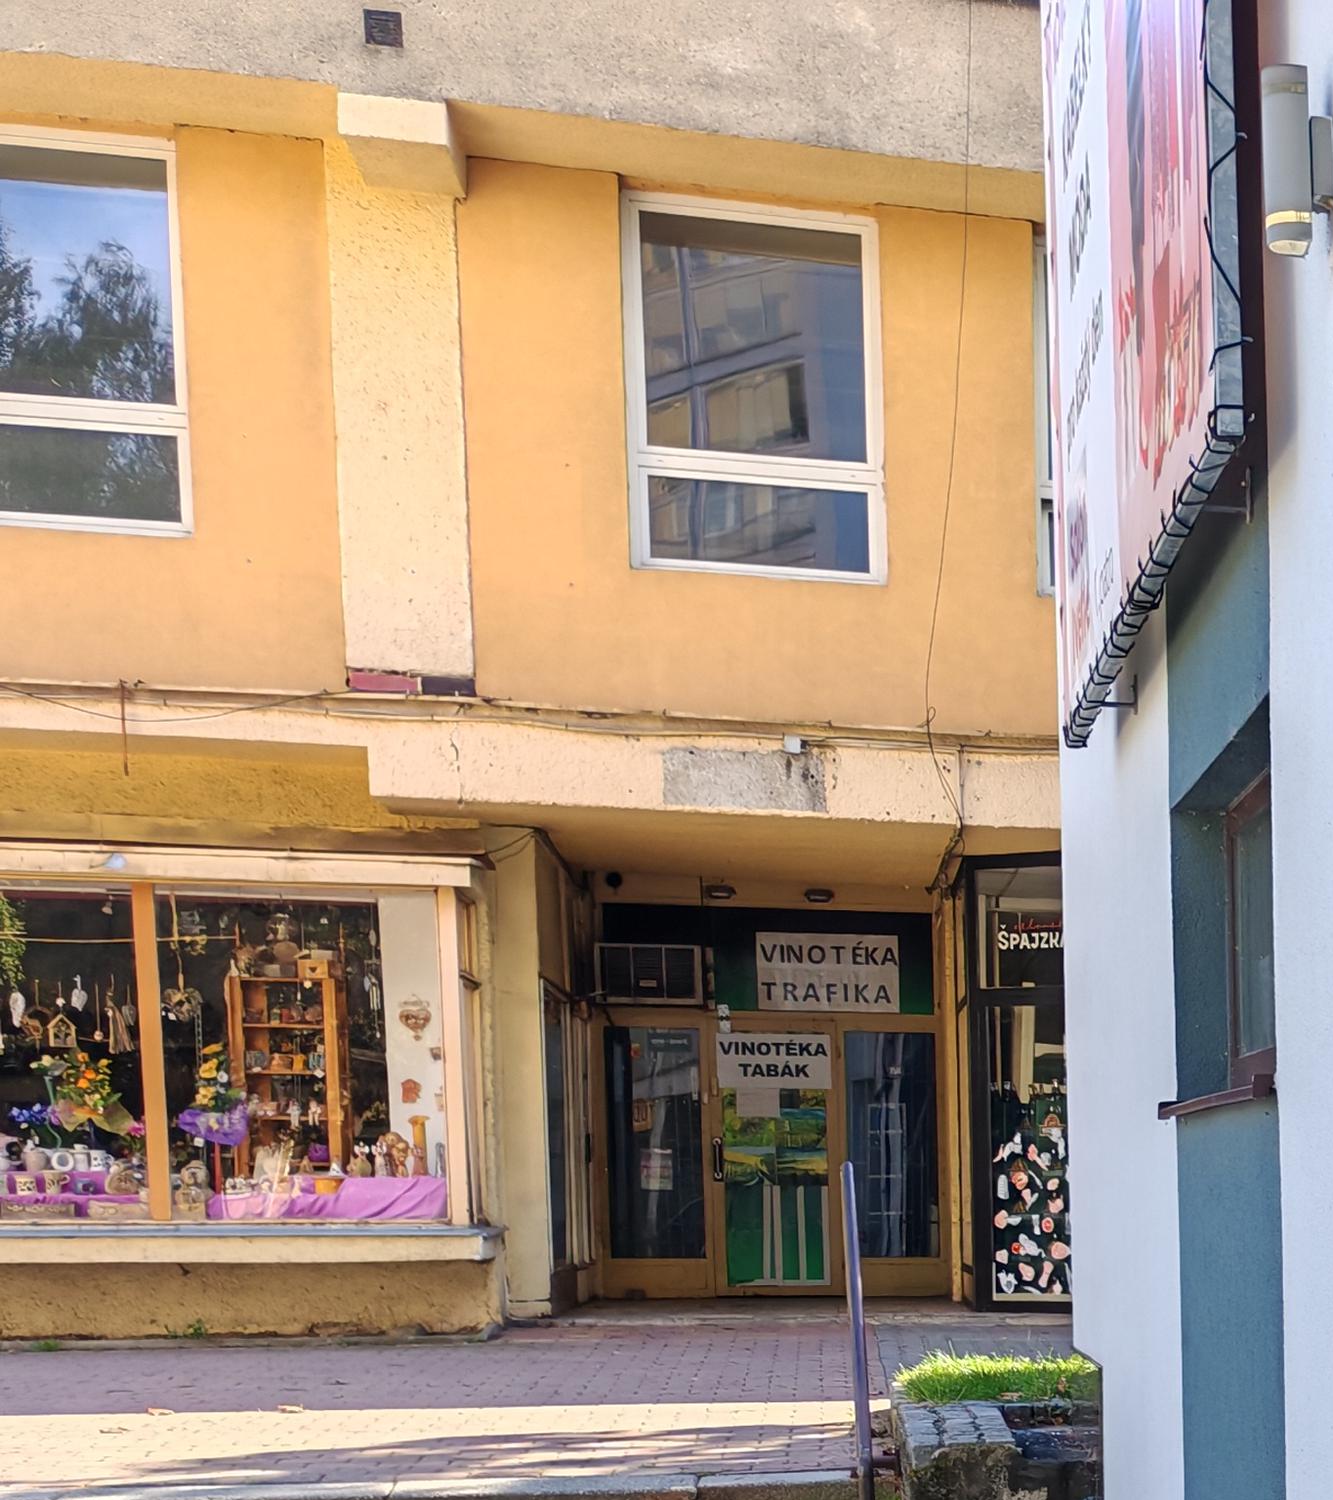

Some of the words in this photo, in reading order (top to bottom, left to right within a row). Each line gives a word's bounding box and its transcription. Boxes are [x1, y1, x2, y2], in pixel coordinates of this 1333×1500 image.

[759, 940, 898, 966] VINOTÉKA
[760, 981, 892, 1004] TRAFIKA
[719, 1039, 828, 1057] VINOTÉKA
[738, 1061, 810, 1078] TABÁK
